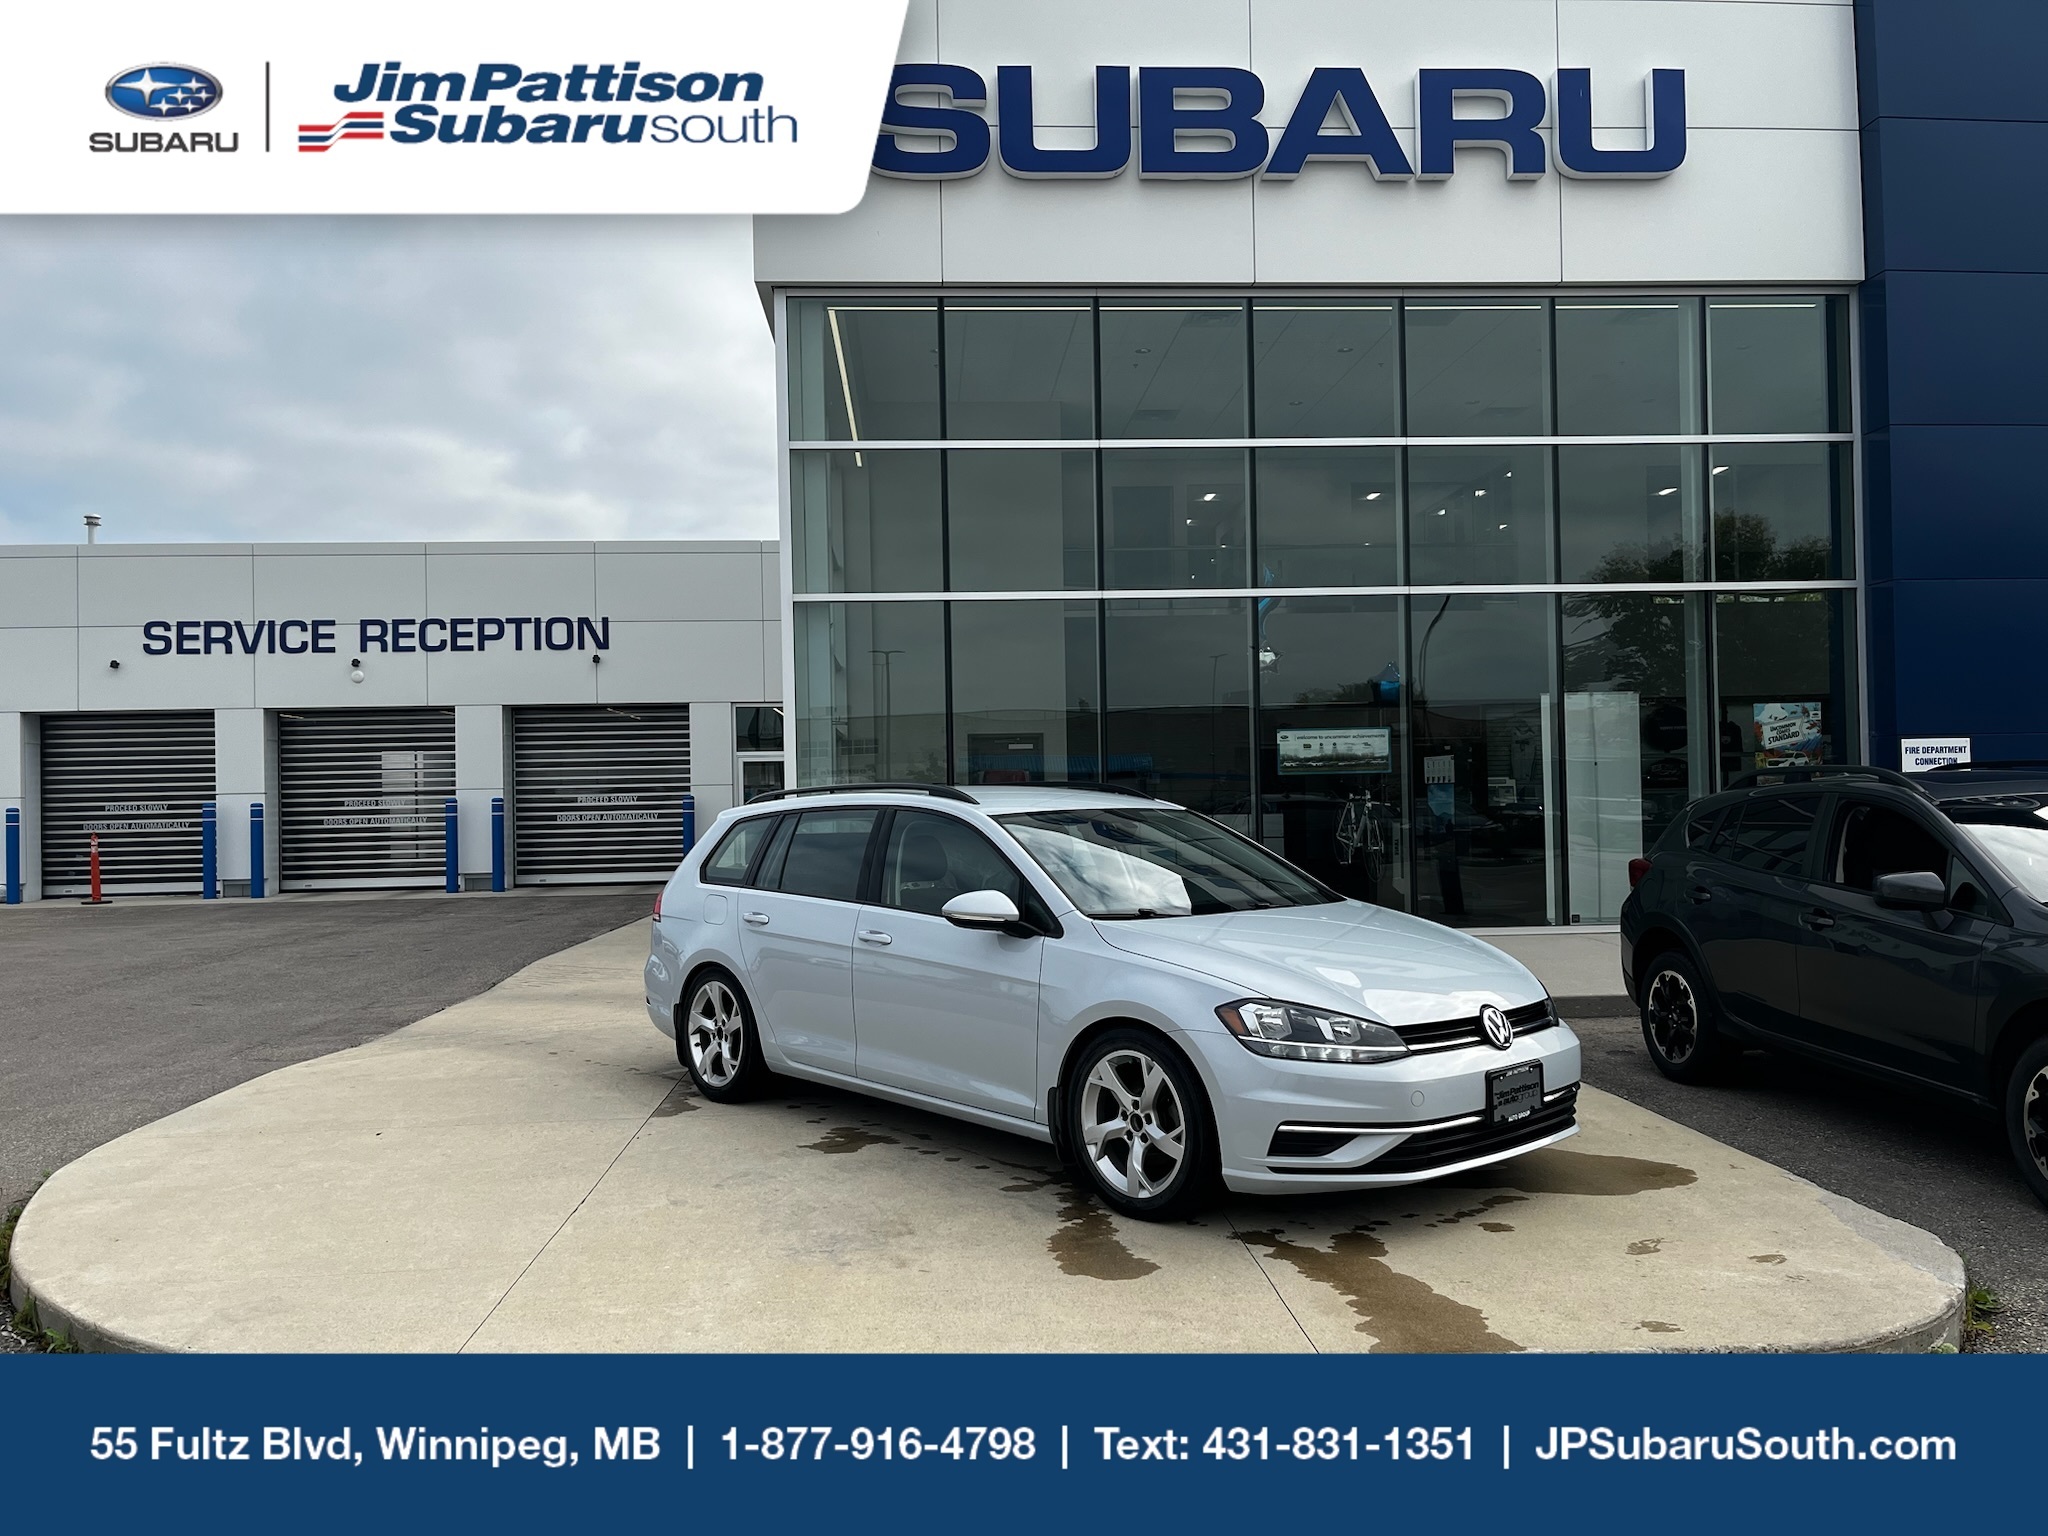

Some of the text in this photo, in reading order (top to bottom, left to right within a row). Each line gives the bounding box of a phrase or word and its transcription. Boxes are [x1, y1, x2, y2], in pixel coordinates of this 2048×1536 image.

[870, 64, 1687, 181] SUBARU
[142, 617, 611, 655] SERVICE RECEPTION
[1770, 722, 1797, 732] UNCOMMON
[1776, 728, 1791, 736] COMES
[1768, 731, 1800, 745] STANDARD
[1905, 746, 1967, 755] FIRE DEPARTMENT
[1915, 757, 1958, 766] CONNECTION
[378, 799, 406, 807] SLOWLY
[577, 795, 638, 804] PROCEED SLOWLY
[105, 804, 168, 812] PROCEED SLOWLY
[323, 818, 347, 826] DOORS
[370, 816, 428, 825] AUTOMATICALLY
[557, 814, 580, 822] DOORS
[602, 812, 659, 821] AUTOMATICALLY
[83, 821, 190, 831] DOORS OPEN AUTOMATICALLY
[1510, 1082, 1539, 1095] Pattison
[1518, 1109, 1531, 1119] GROUP
